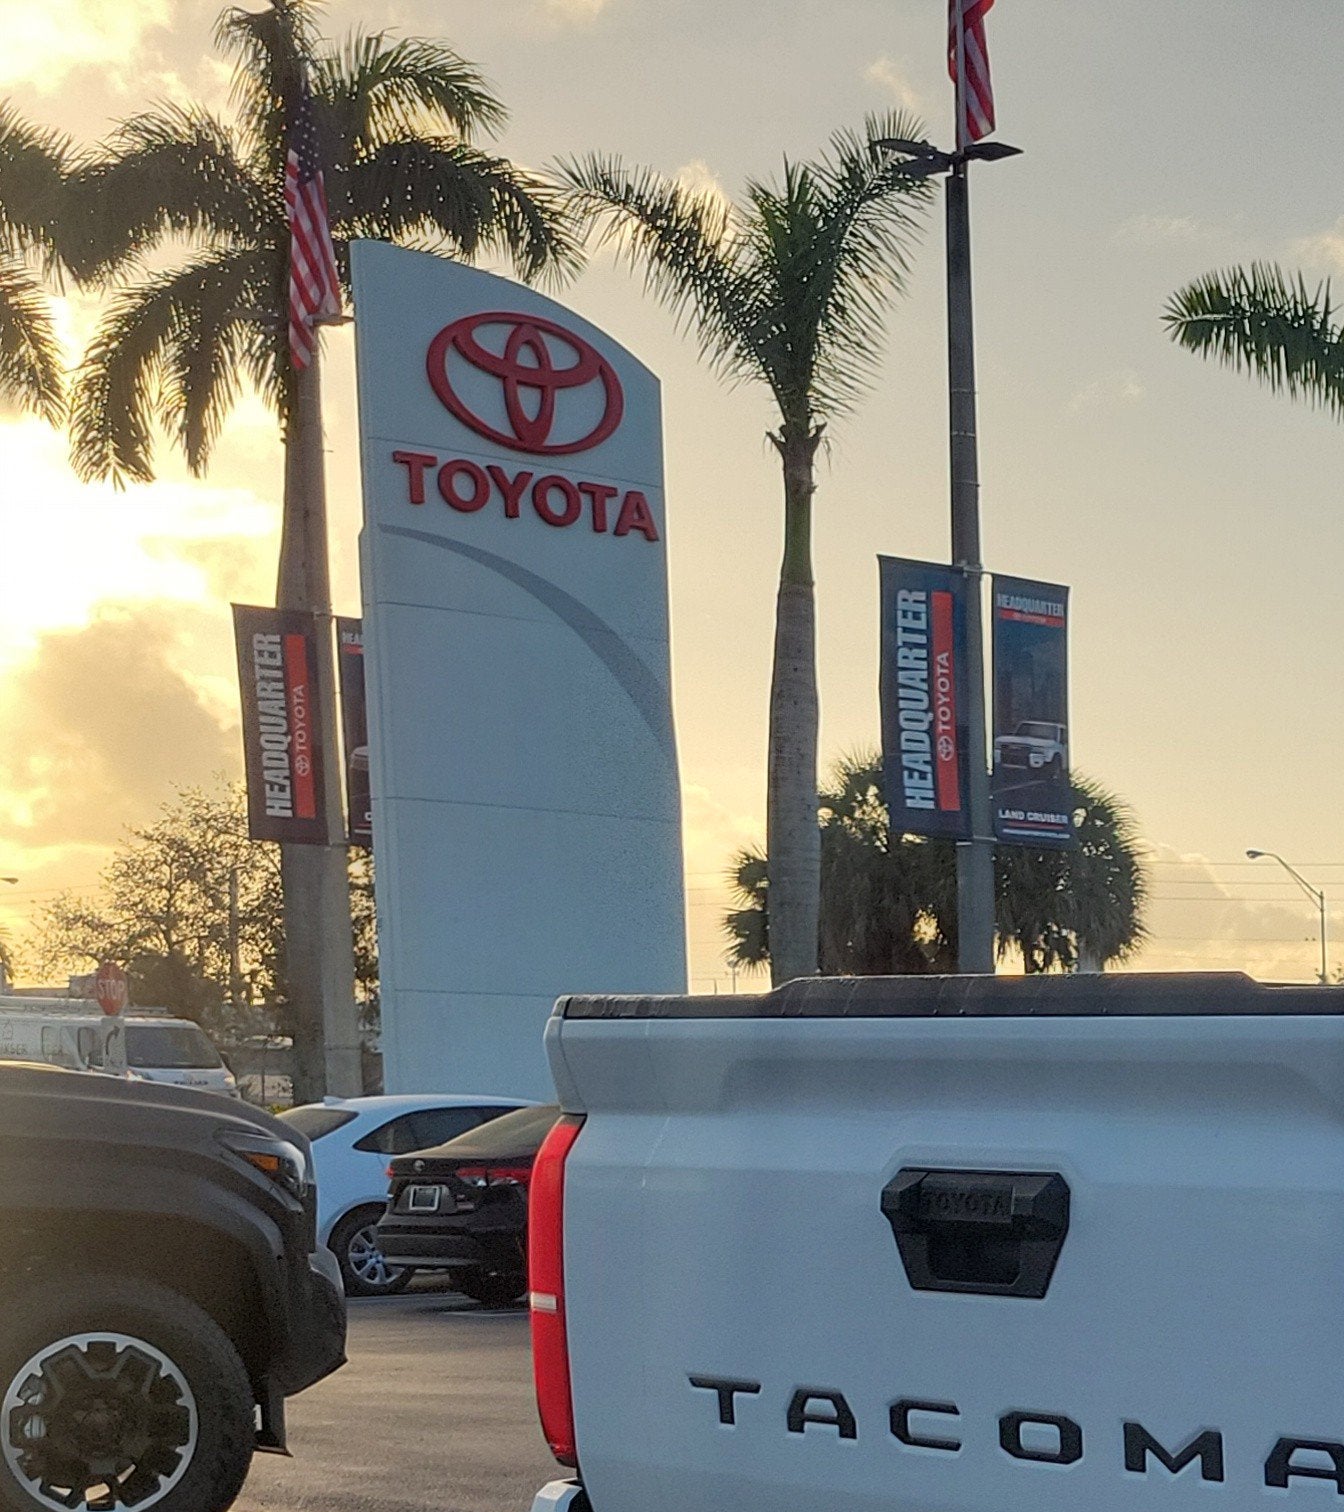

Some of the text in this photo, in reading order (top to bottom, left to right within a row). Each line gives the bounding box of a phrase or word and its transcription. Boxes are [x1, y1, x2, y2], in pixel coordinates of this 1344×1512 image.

[392, 450, 659, 542] TOYOTA
[253, 632, 293, 818] HEADQUARTER
[292, 684, 308, 750] TOYOTA
[896, 588, 935, 810] HEADQUARTER
[937, 652, 950, 733] TOYOTA
[998, 808, 1069, 824] LAND CRUISER
[98, 979, 125, 1000] STOP
